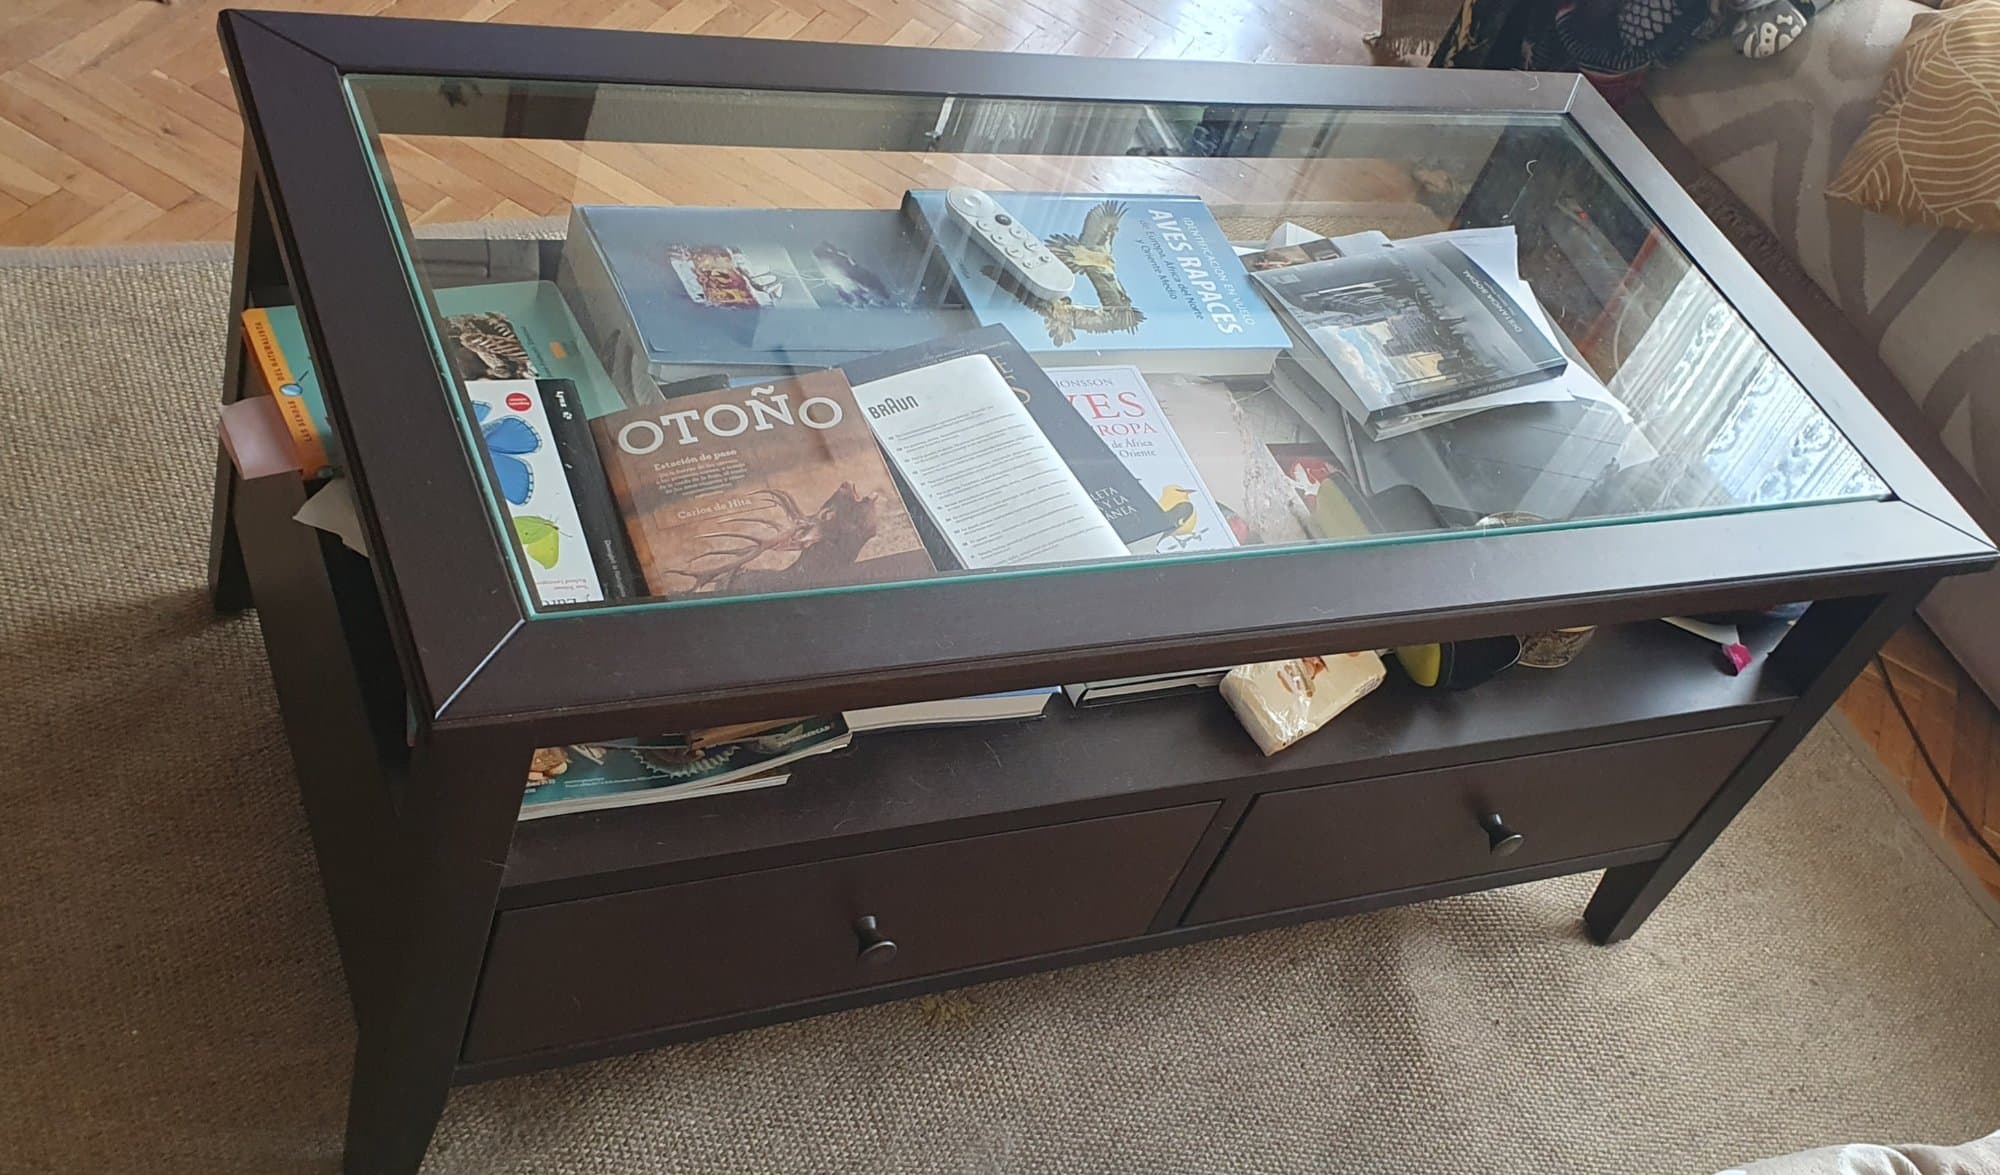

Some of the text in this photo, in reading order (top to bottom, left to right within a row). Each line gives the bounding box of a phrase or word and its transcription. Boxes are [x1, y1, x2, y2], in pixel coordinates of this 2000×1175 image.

[1148, 208, 1243, 336] AVES RAPACES
[1160, 274, 1178, 300] Medio
[1233, 297, 1256, 326] VUELO
[868, 395, 919, 419] BRAUN
[618, 384, 844, 456] OTOÑO
[654, 449, 737, 472] Estación de paso
[1119, 449, 1158, 458] Oriente
[678, 506, 712, 519] Carlos
[712, 502, 727, 512] de
